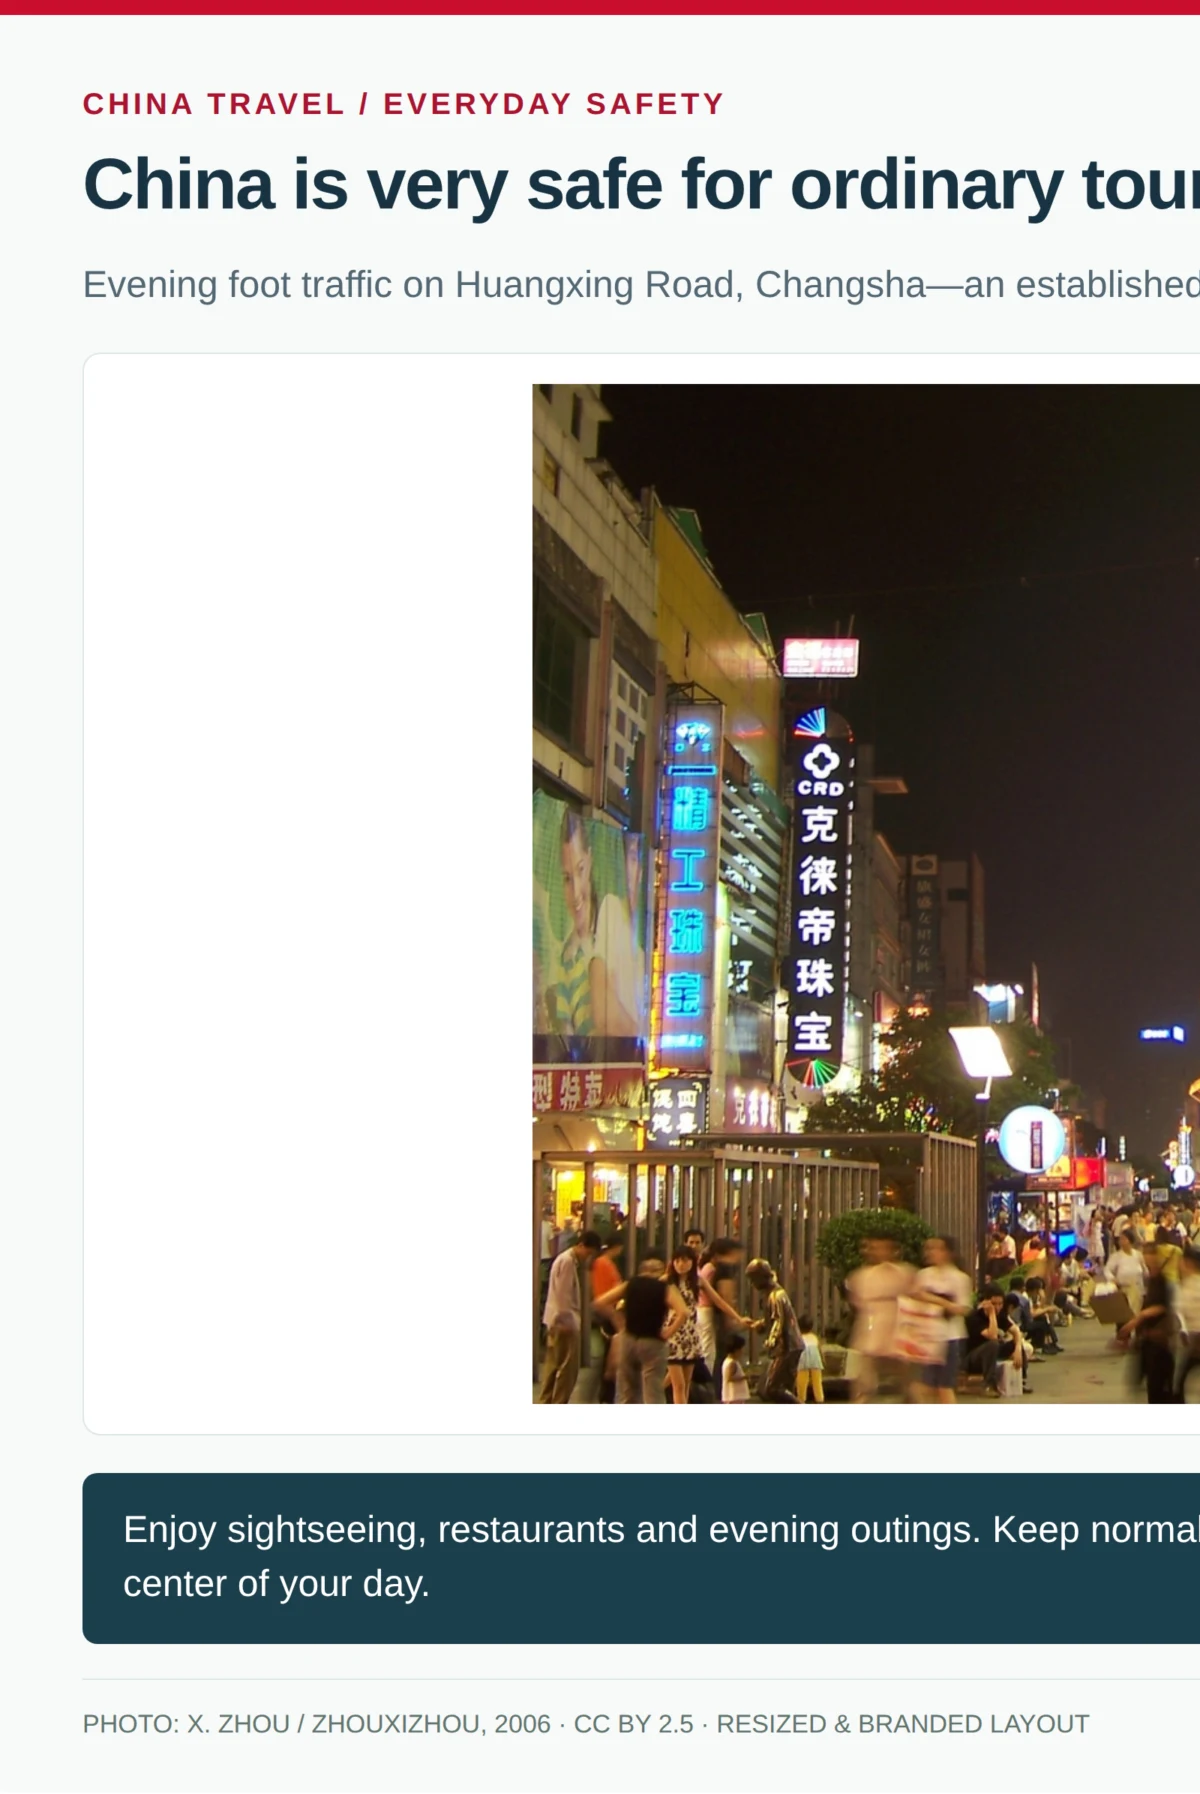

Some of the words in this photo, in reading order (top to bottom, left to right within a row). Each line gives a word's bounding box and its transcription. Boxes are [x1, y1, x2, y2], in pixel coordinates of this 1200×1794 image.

[797, 779, 845, 797] CRD
[793, 805, 839, 1051] 克徕帝珠宝
